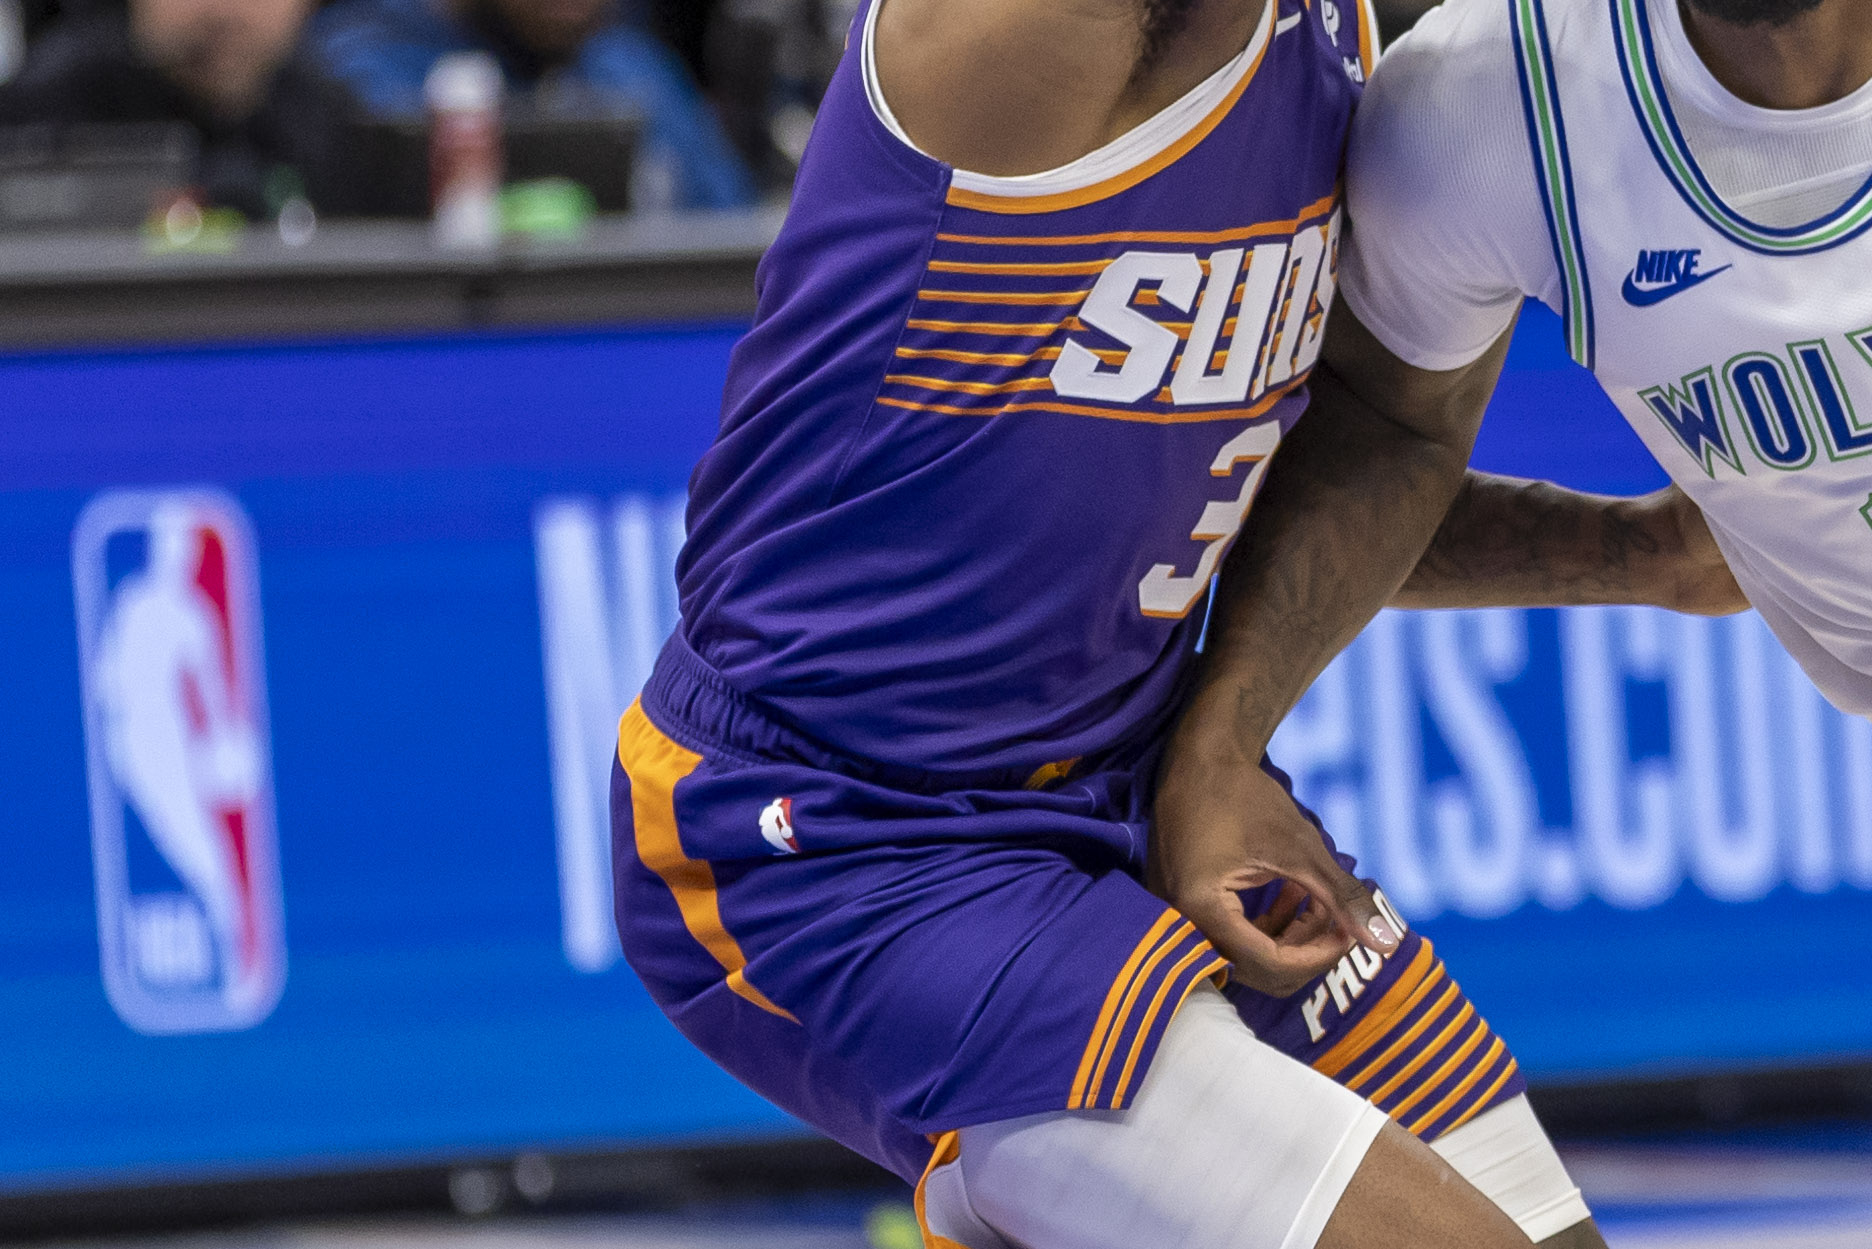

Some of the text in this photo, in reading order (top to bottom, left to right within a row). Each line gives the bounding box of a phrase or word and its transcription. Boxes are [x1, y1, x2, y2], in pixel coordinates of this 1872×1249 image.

[1049, 204, 1342, 406] SUNS
[1634, 248, 1702, 284] NIKE
[1138, 419, 1281, 619] 3
